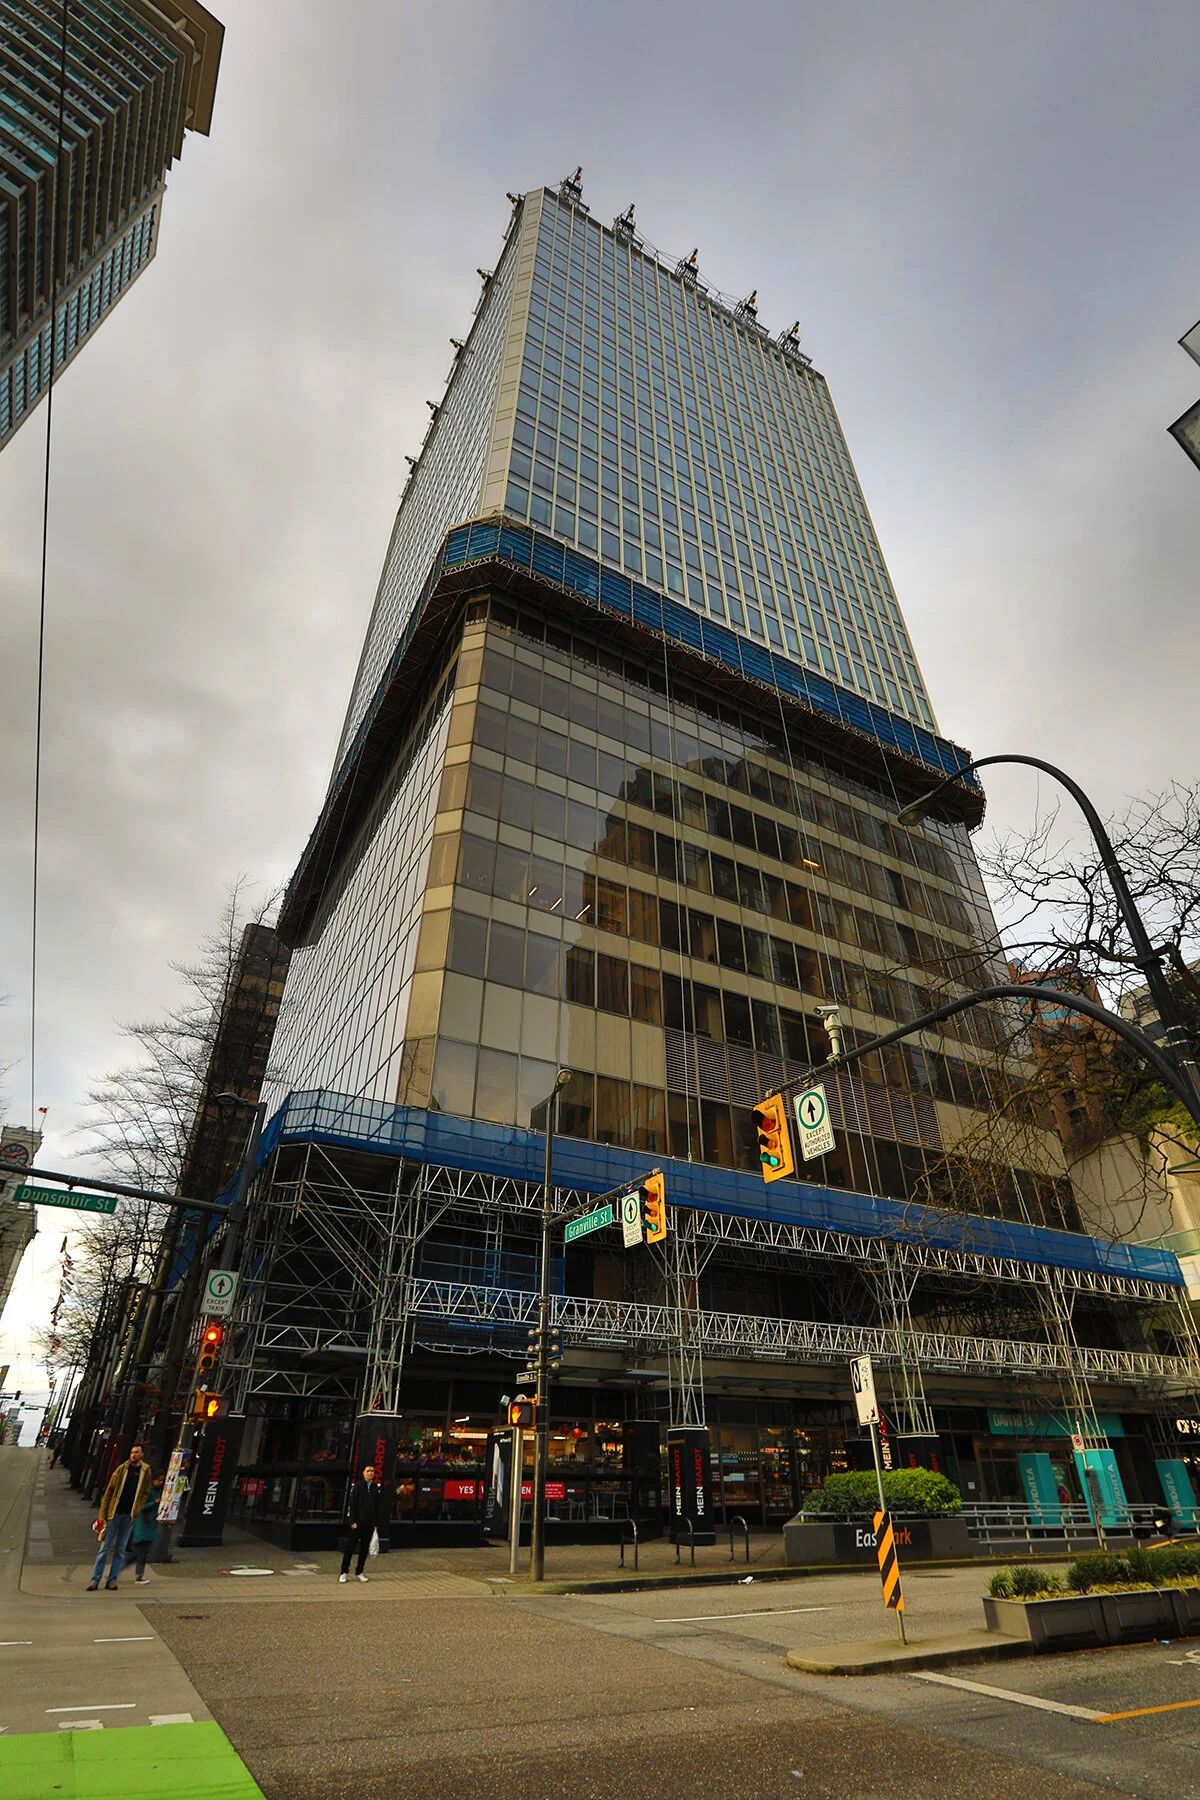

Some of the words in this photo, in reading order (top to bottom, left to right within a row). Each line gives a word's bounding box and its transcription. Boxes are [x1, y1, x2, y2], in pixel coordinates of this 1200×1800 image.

[806, 1126, 825, 1140] EXCEPT
[807, 1141, 831, 1155] VEHICLES
[21, 1188, 91, 1208] Dunsmuir
[96, 1199, 111, 1211] St
[569, 1216, 598, 1237] Granville
[600, 1210, 608, 1224] St
[202, 1436, 227, 1515] MEINHARDT
[673, 1447, 682, 1516] MEINHARDT
[693, 1447, 705, 1516] MEINHARDT
[458, 1486, 473, 1495] YES
[521, 1486, 532, 1495] EN
[856, 1526, 912, 1548] Easark
